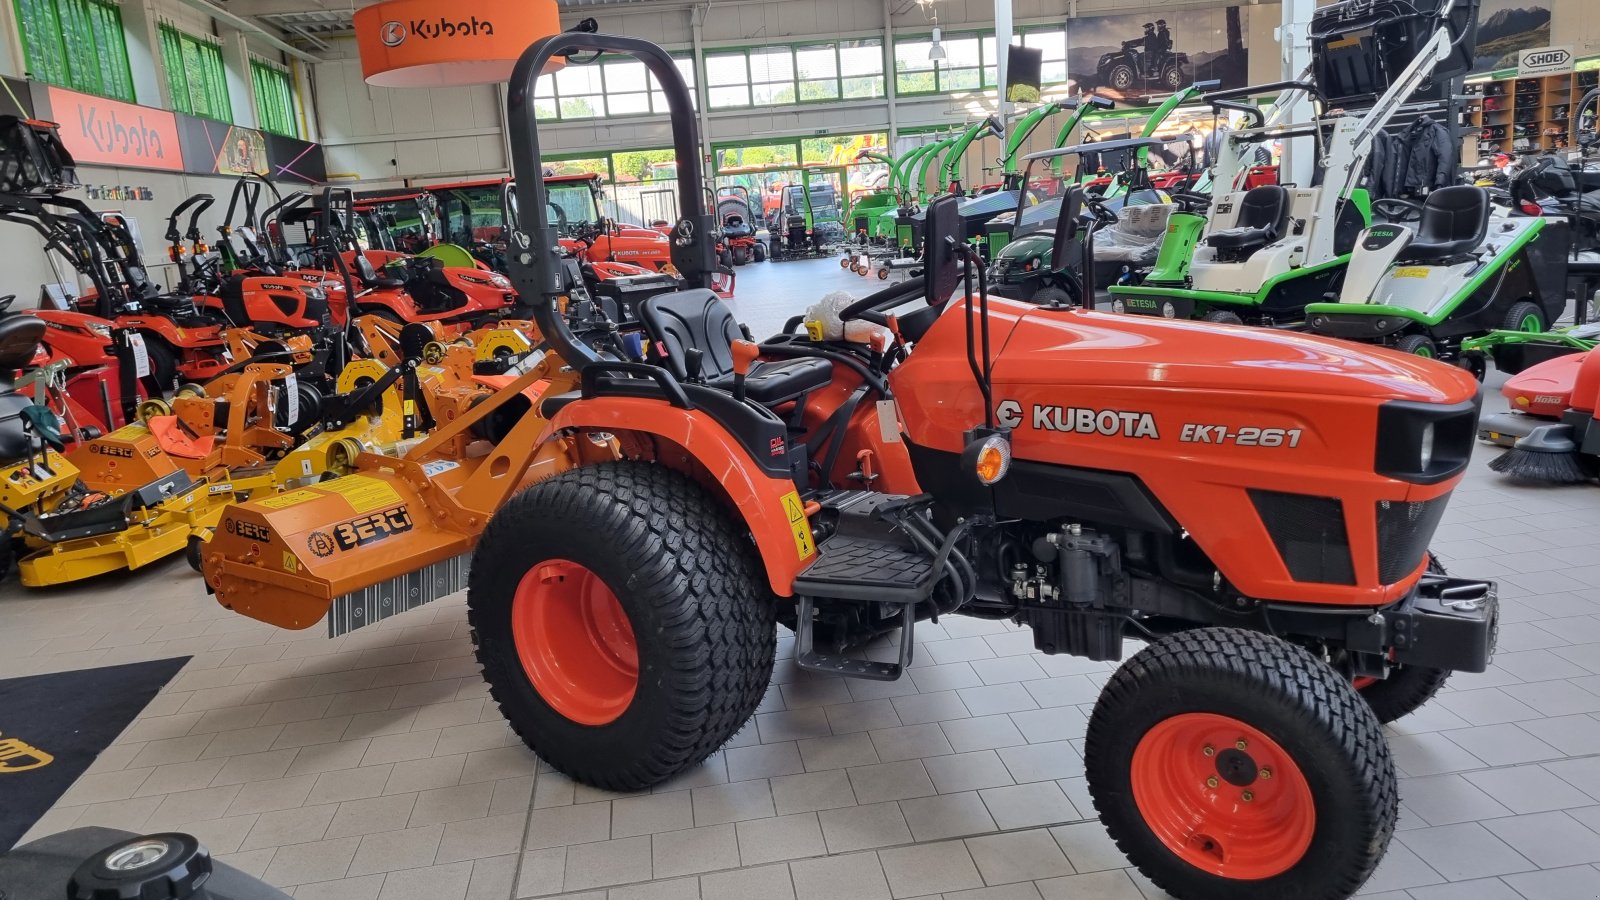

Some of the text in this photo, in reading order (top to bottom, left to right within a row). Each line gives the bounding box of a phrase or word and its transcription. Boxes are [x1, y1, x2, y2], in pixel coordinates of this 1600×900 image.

[410, 16, 494, 39] Kubota
[1529, 52, 1563, 65] SHOEI
[78, 103, 164, 159] Kubota
[1126, 298, 1158, 309] ETESIA
[1032, 404, 1160, 439] KUBOTA
[1179, 423, 1303, 449] EK1-261
